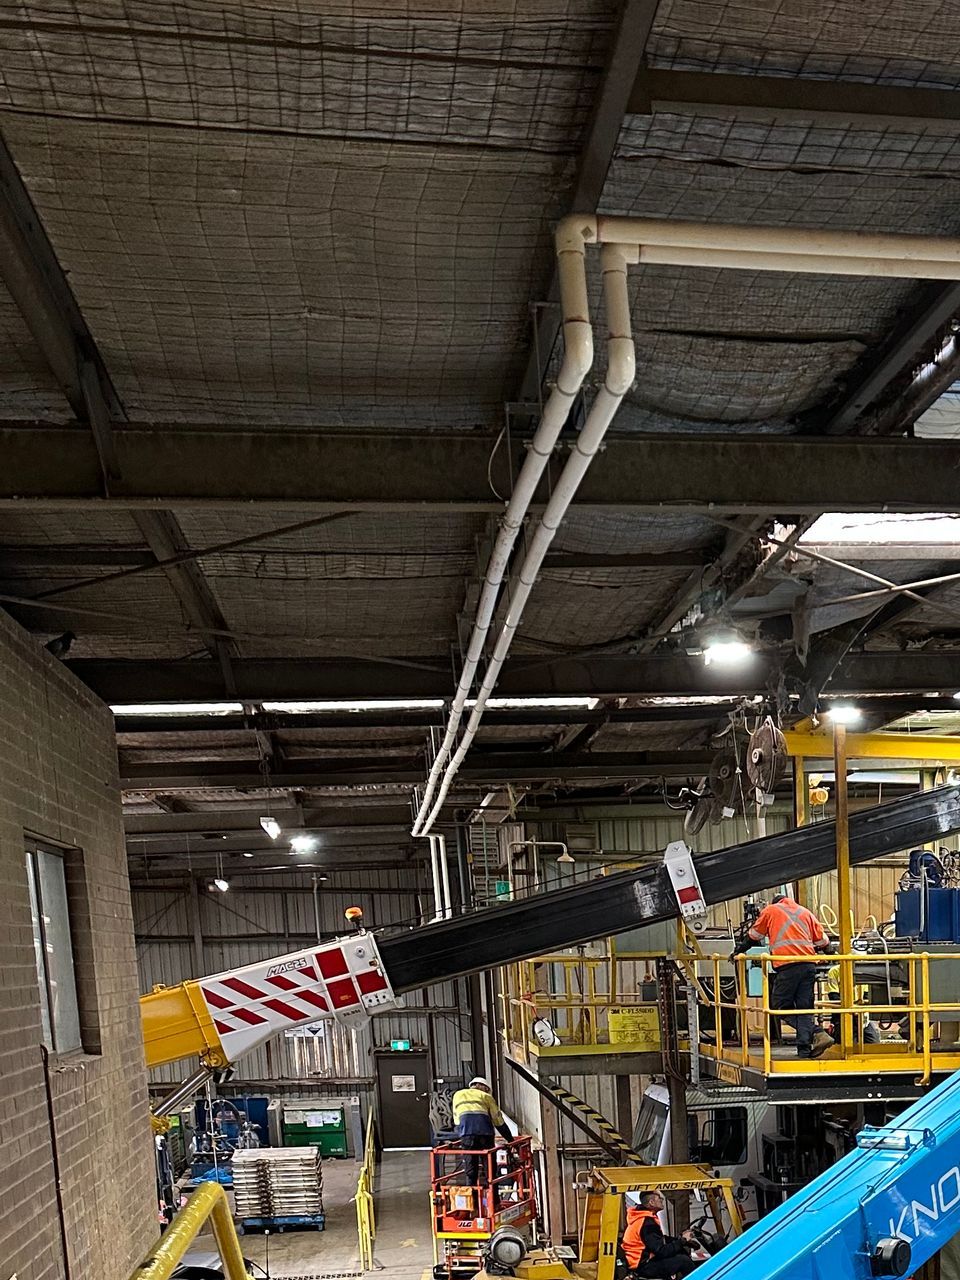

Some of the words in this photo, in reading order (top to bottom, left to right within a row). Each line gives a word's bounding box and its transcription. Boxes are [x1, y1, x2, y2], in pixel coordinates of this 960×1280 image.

[627, 1184, 650, 1192] LIFT
[655, 1182, 678, 1190] AND
[682, 1181, 716, 1189] SHIFT
